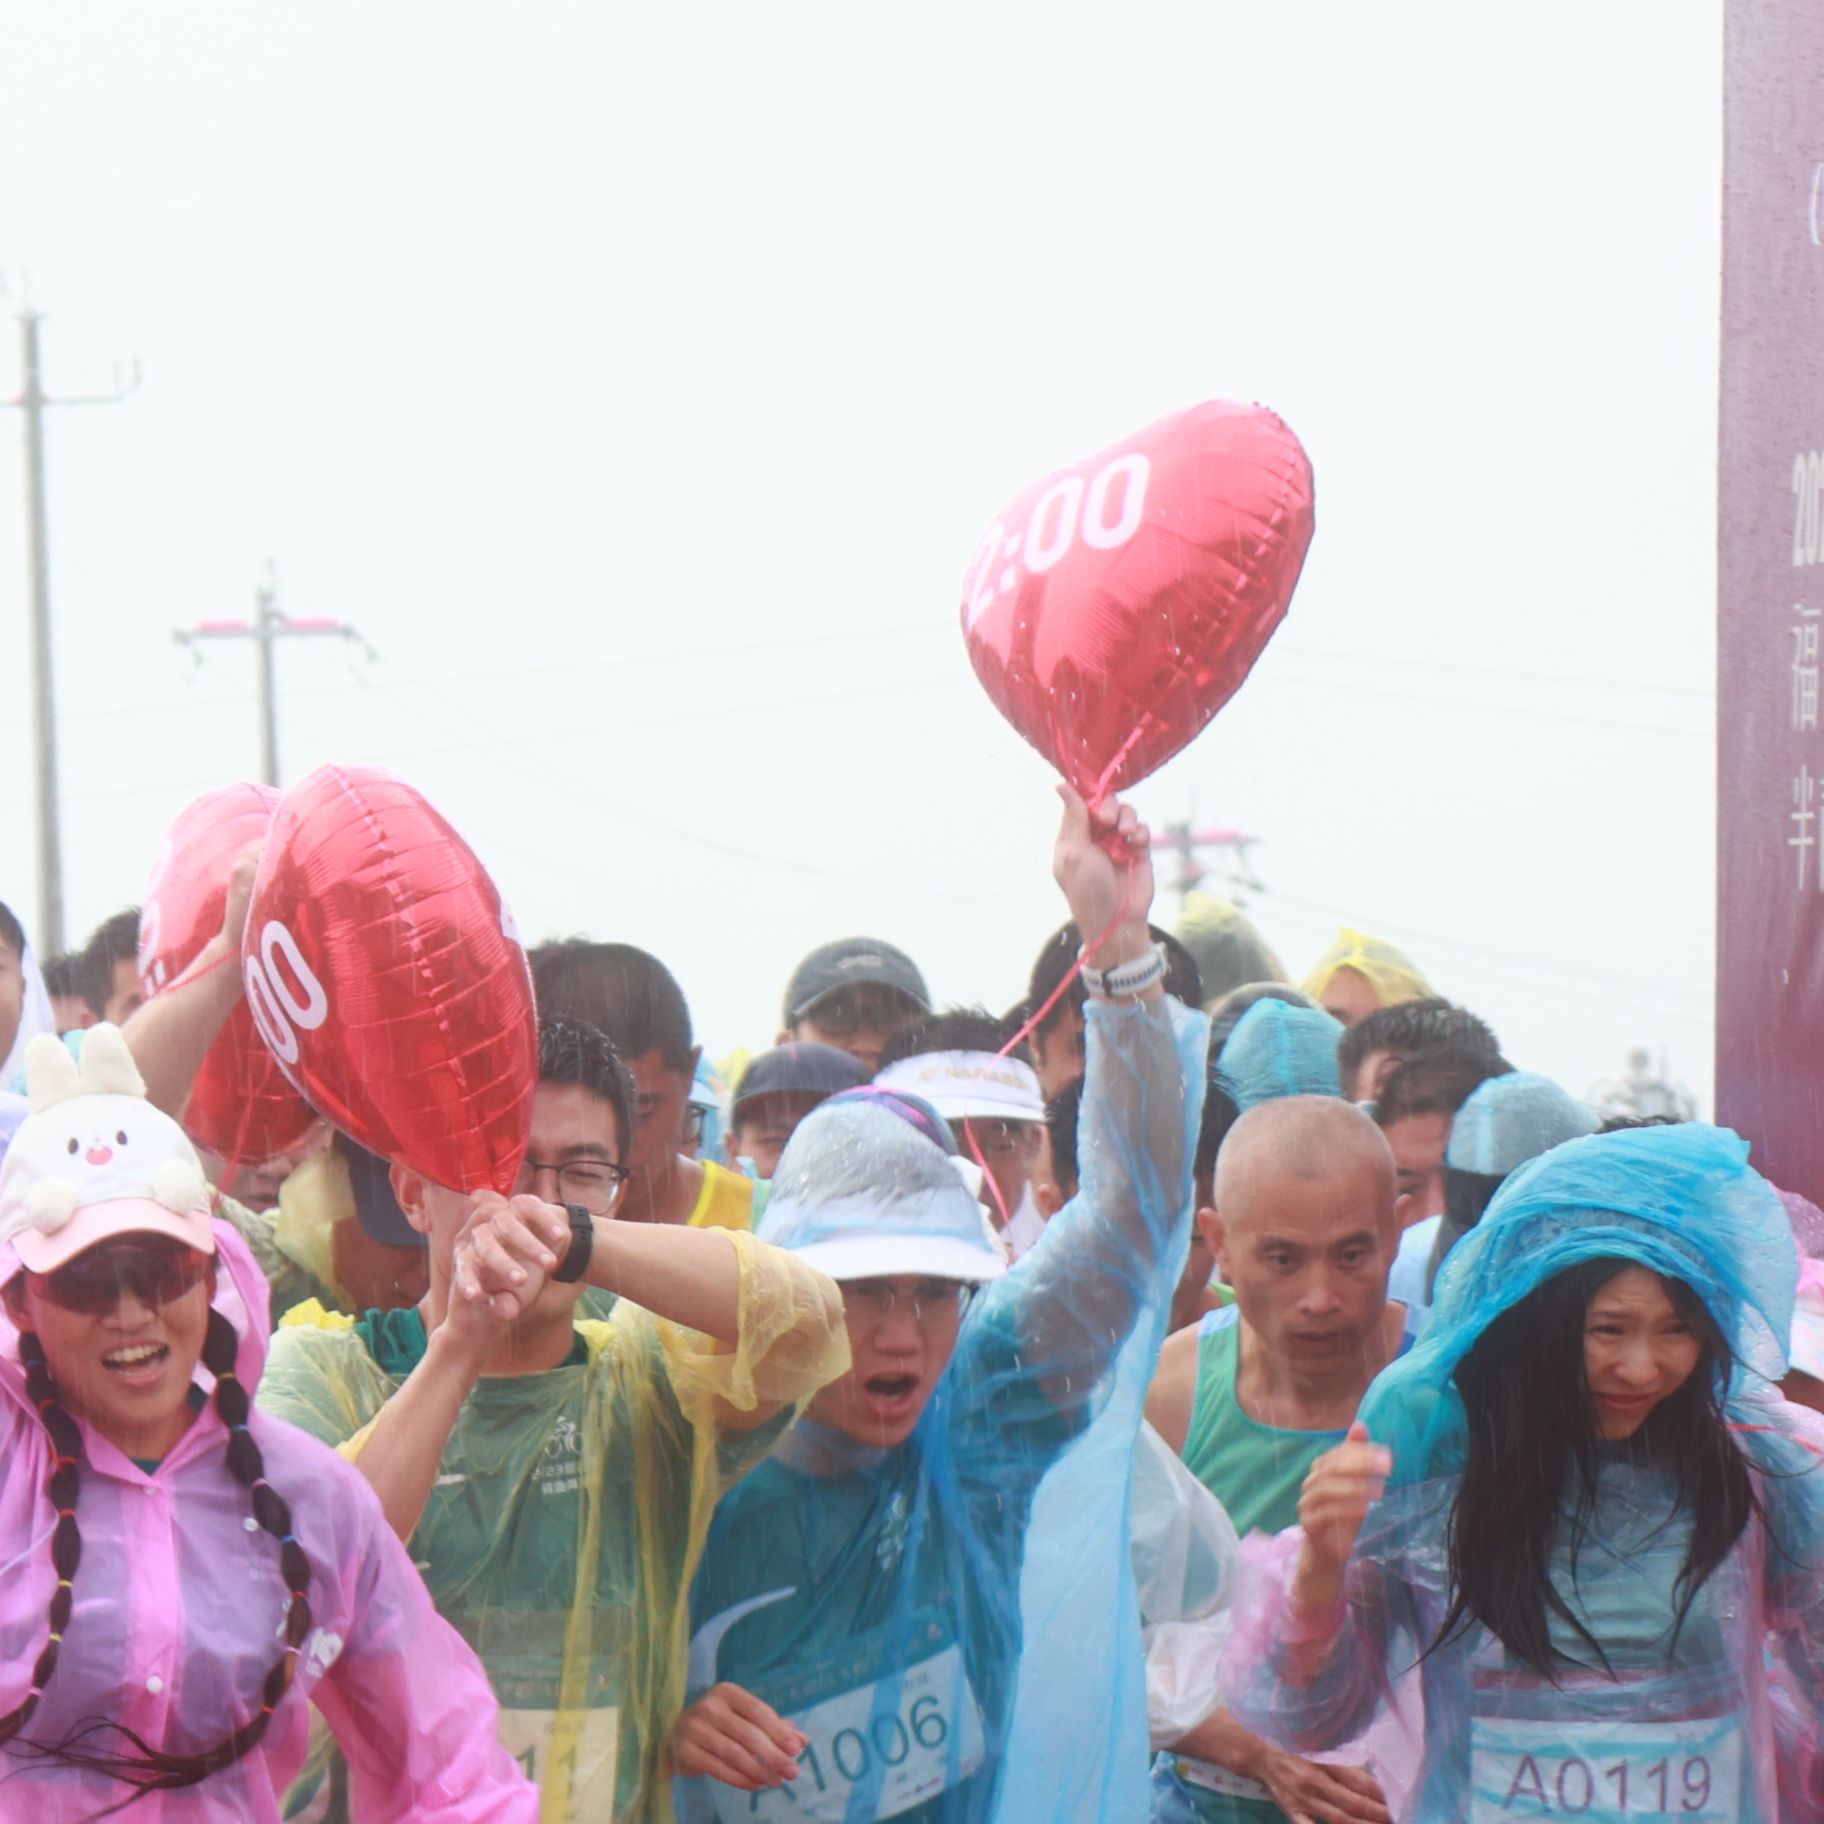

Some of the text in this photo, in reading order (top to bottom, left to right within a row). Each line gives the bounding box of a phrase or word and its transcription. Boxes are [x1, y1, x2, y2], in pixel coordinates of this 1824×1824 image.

[966, 452, 1151, 630] 2:00
[1793, 452, 1824, 566] 20
[1788, 762, 1824, 893] 半
[1502, 1754, 1711, 1815] A0119
